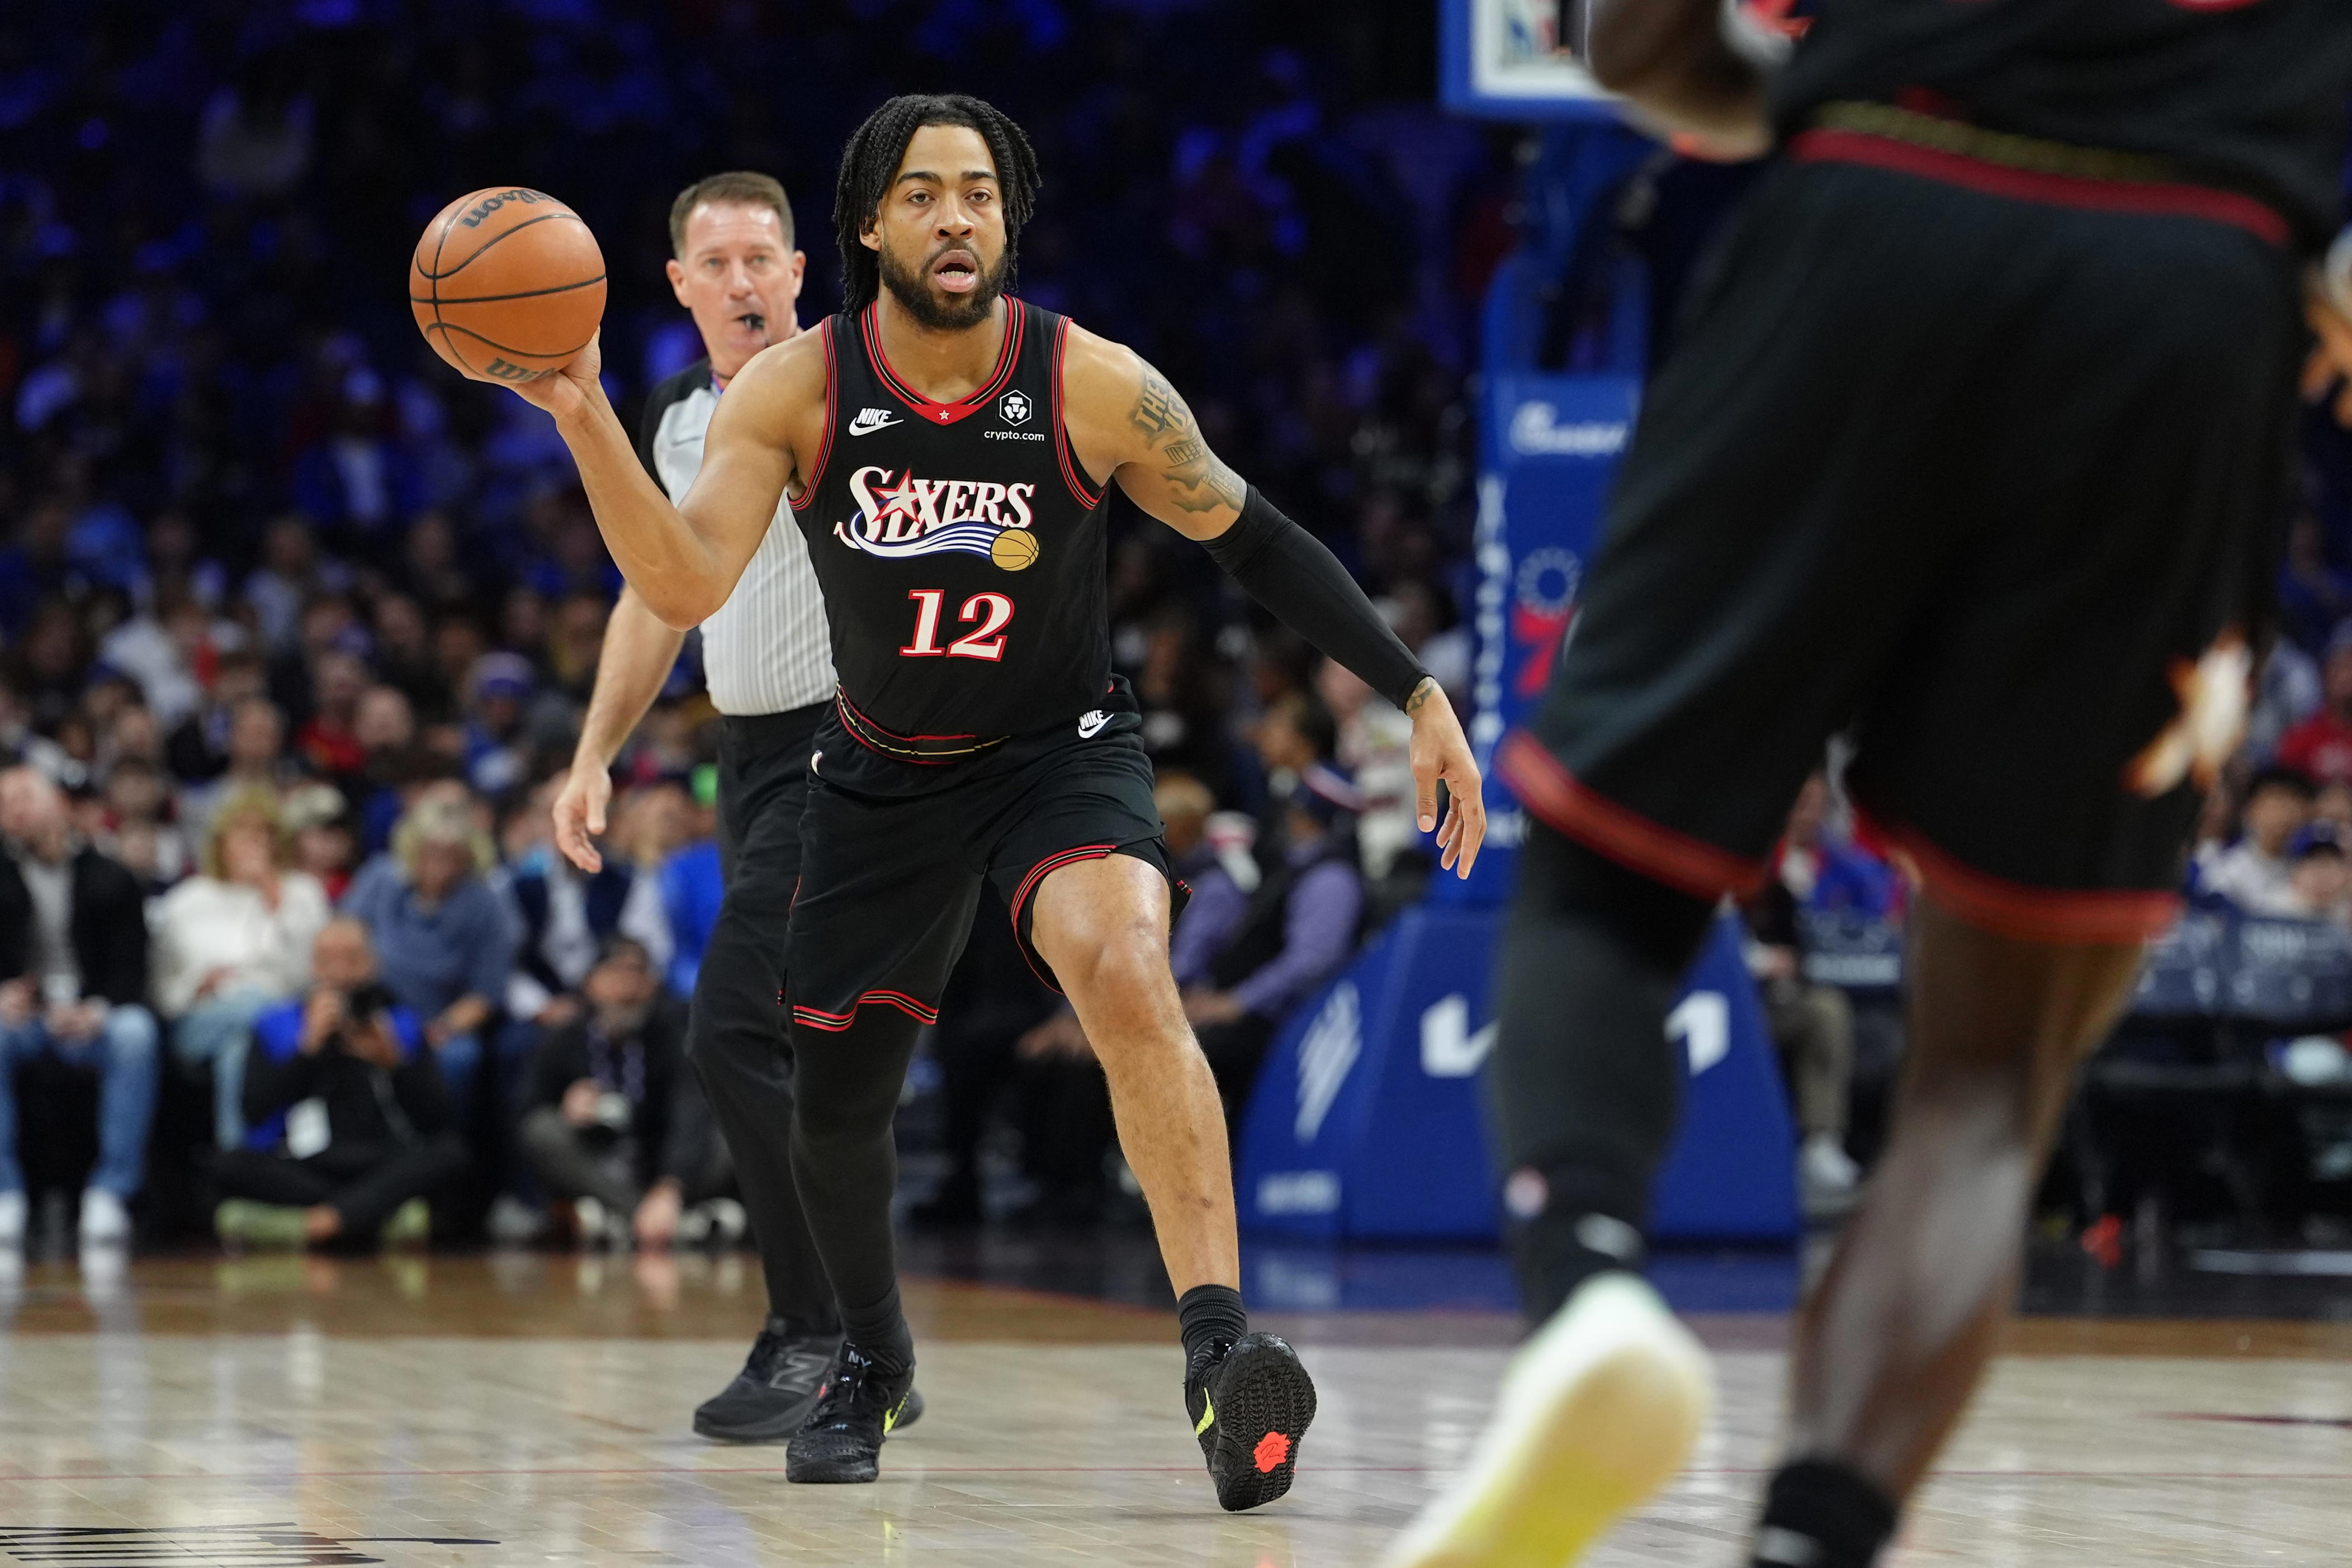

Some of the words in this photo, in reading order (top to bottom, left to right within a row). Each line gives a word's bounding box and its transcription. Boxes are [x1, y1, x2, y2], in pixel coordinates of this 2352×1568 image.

[856, 408, 892, 425] NIKE
[983, 429, 1045, 442] crypto.com
[832, 466, 1036, 551] SIXERS
[899, 589, 1015, 662] 12
[1078, 709, 1104, 730] NIKE
